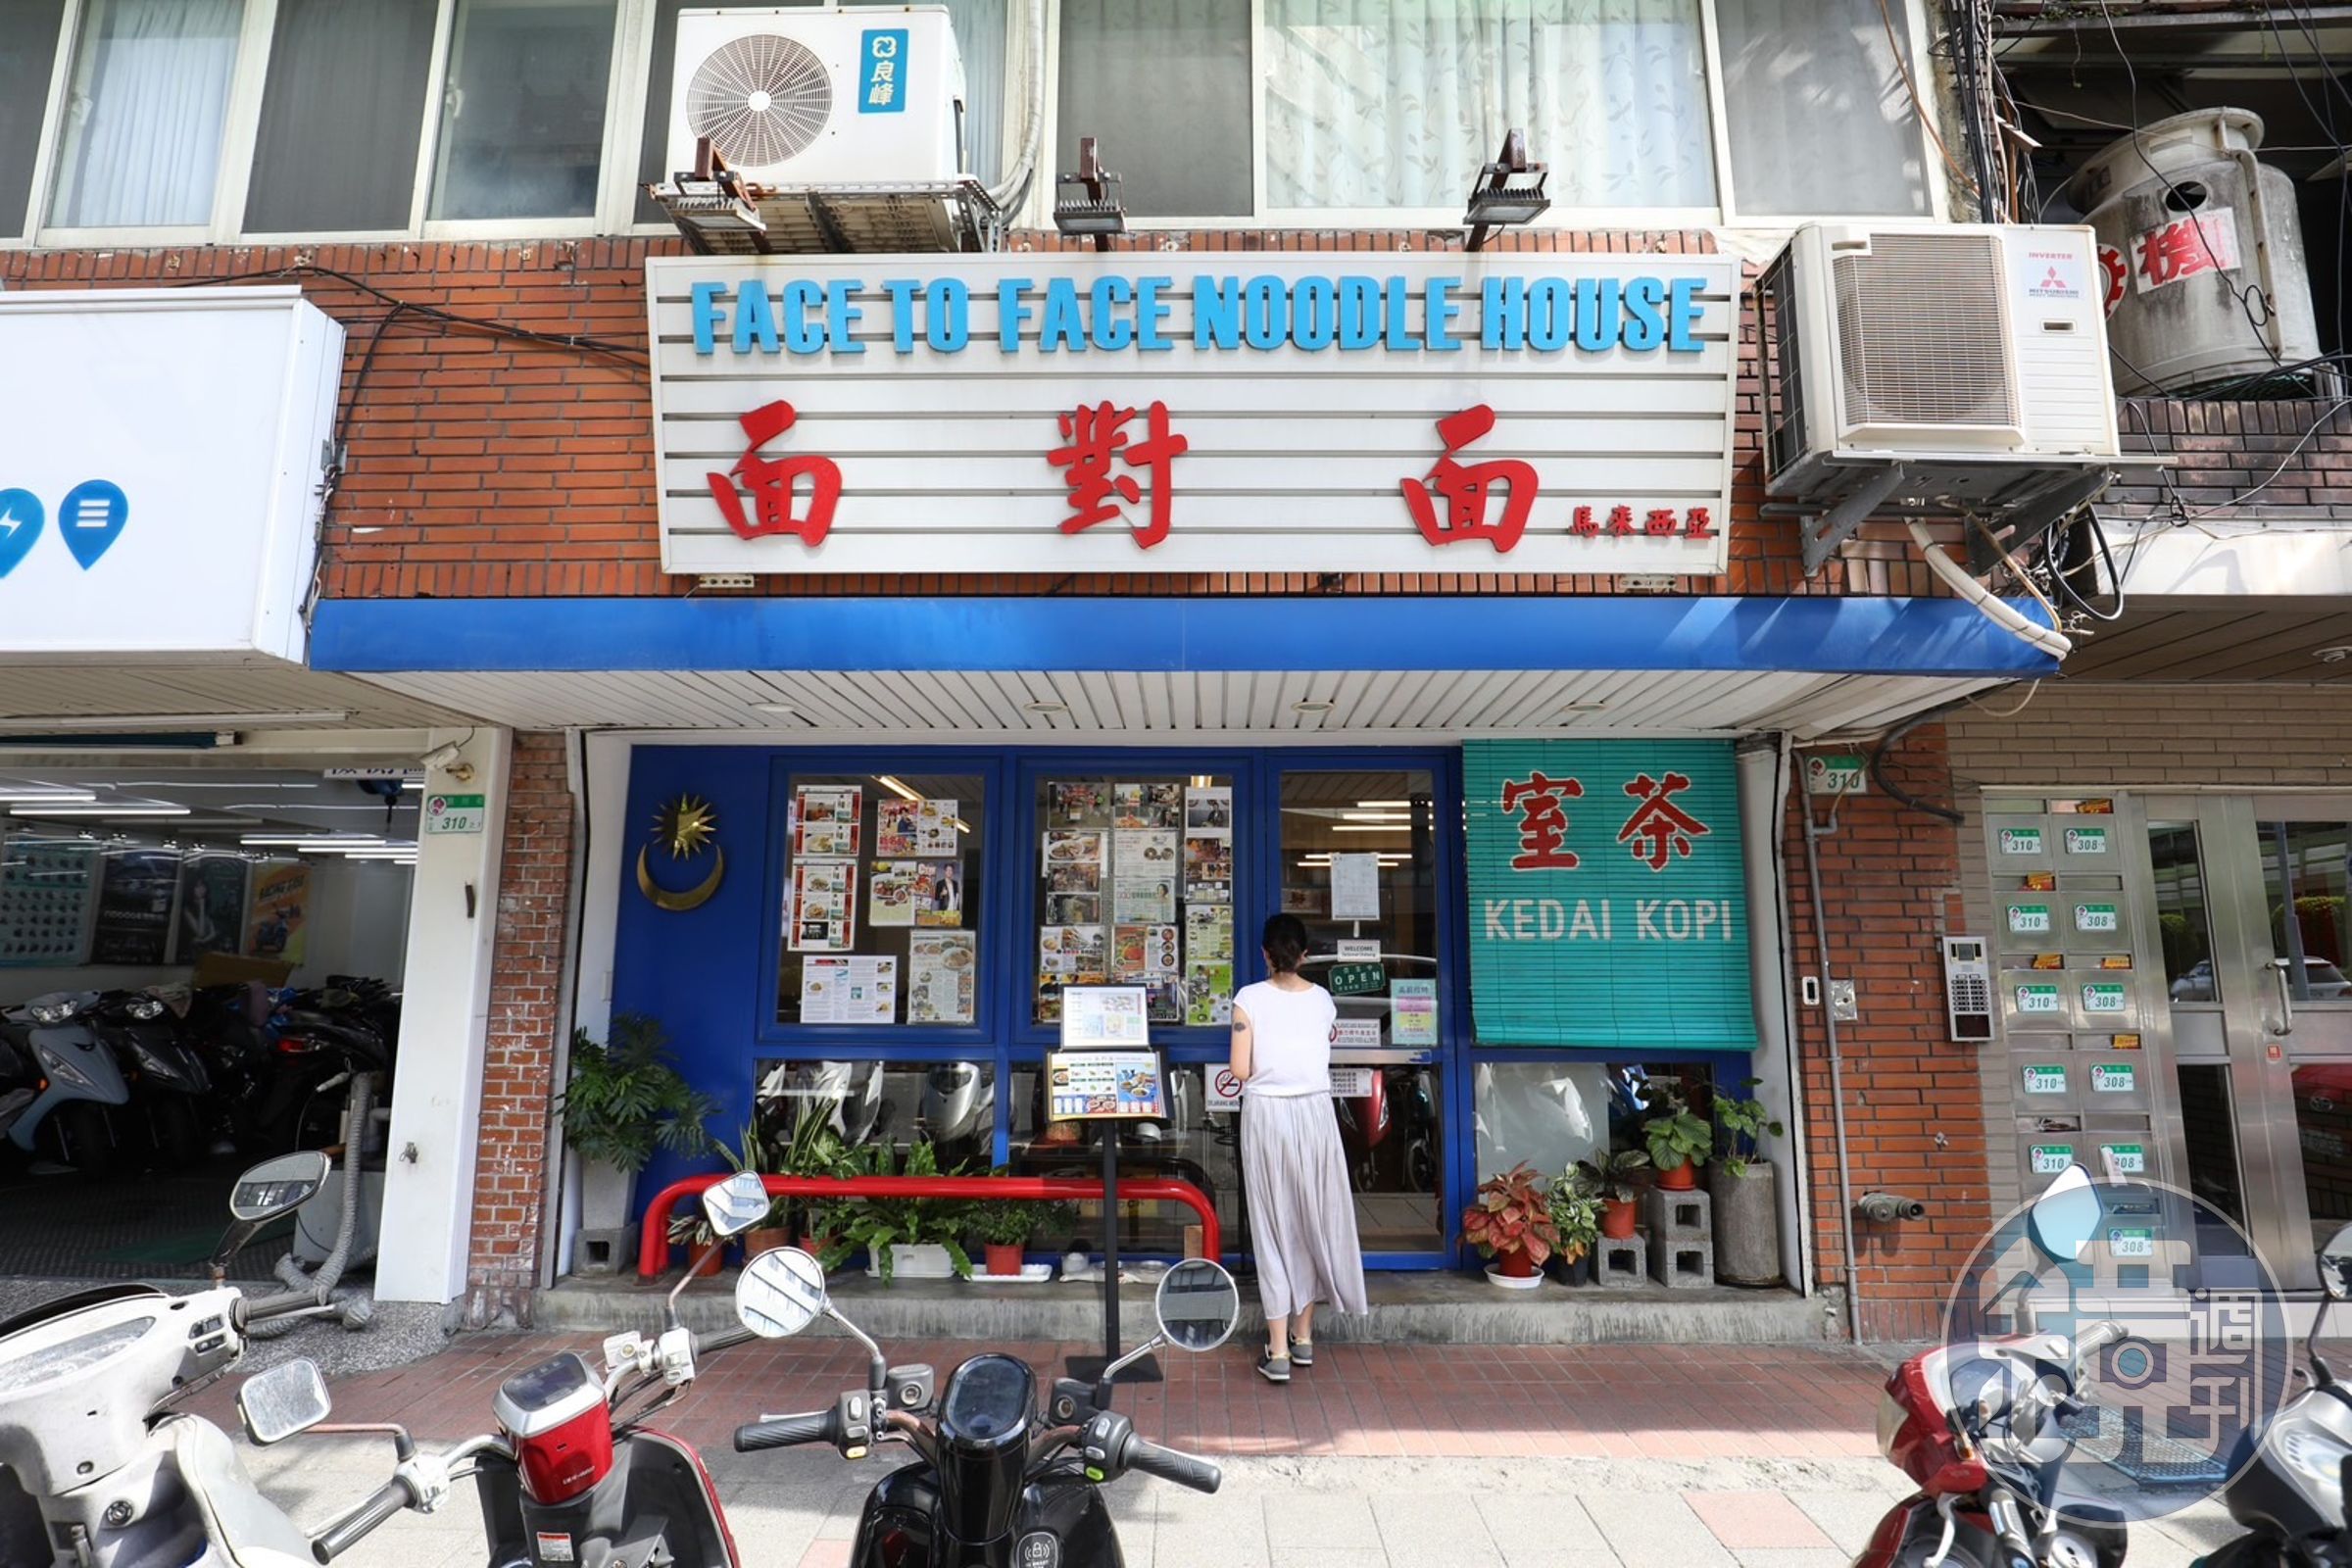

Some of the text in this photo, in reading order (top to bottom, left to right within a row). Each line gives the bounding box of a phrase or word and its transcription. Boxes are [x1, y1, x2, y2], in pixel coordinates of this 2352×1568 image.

[692, 275, 1706, 354] FACE TO FACE NOODLE HOUSE
[1571, 506, 1713, 540] 馬來西亞
[442, 816, 467, 830] 310
[2012, 840, 2034, 851] 310
[2078, 839, 2098, 851] 308
[1484, 899, 1733, 942] KEDAI KOPI
[2020, 916, 2040, 928] 310
[2086, 915, 2108, 927] 308
[1335, 971, 1381, 985] OPEN
[2029, 997, 2050, 1008] 310
[2095, 996, 2116, 1007] 308
[2035, 1078, 2057, 1090] 310
[2103, 1076, 2126, 1088] 308
[2043, 1157, 2065, 1169] 310
